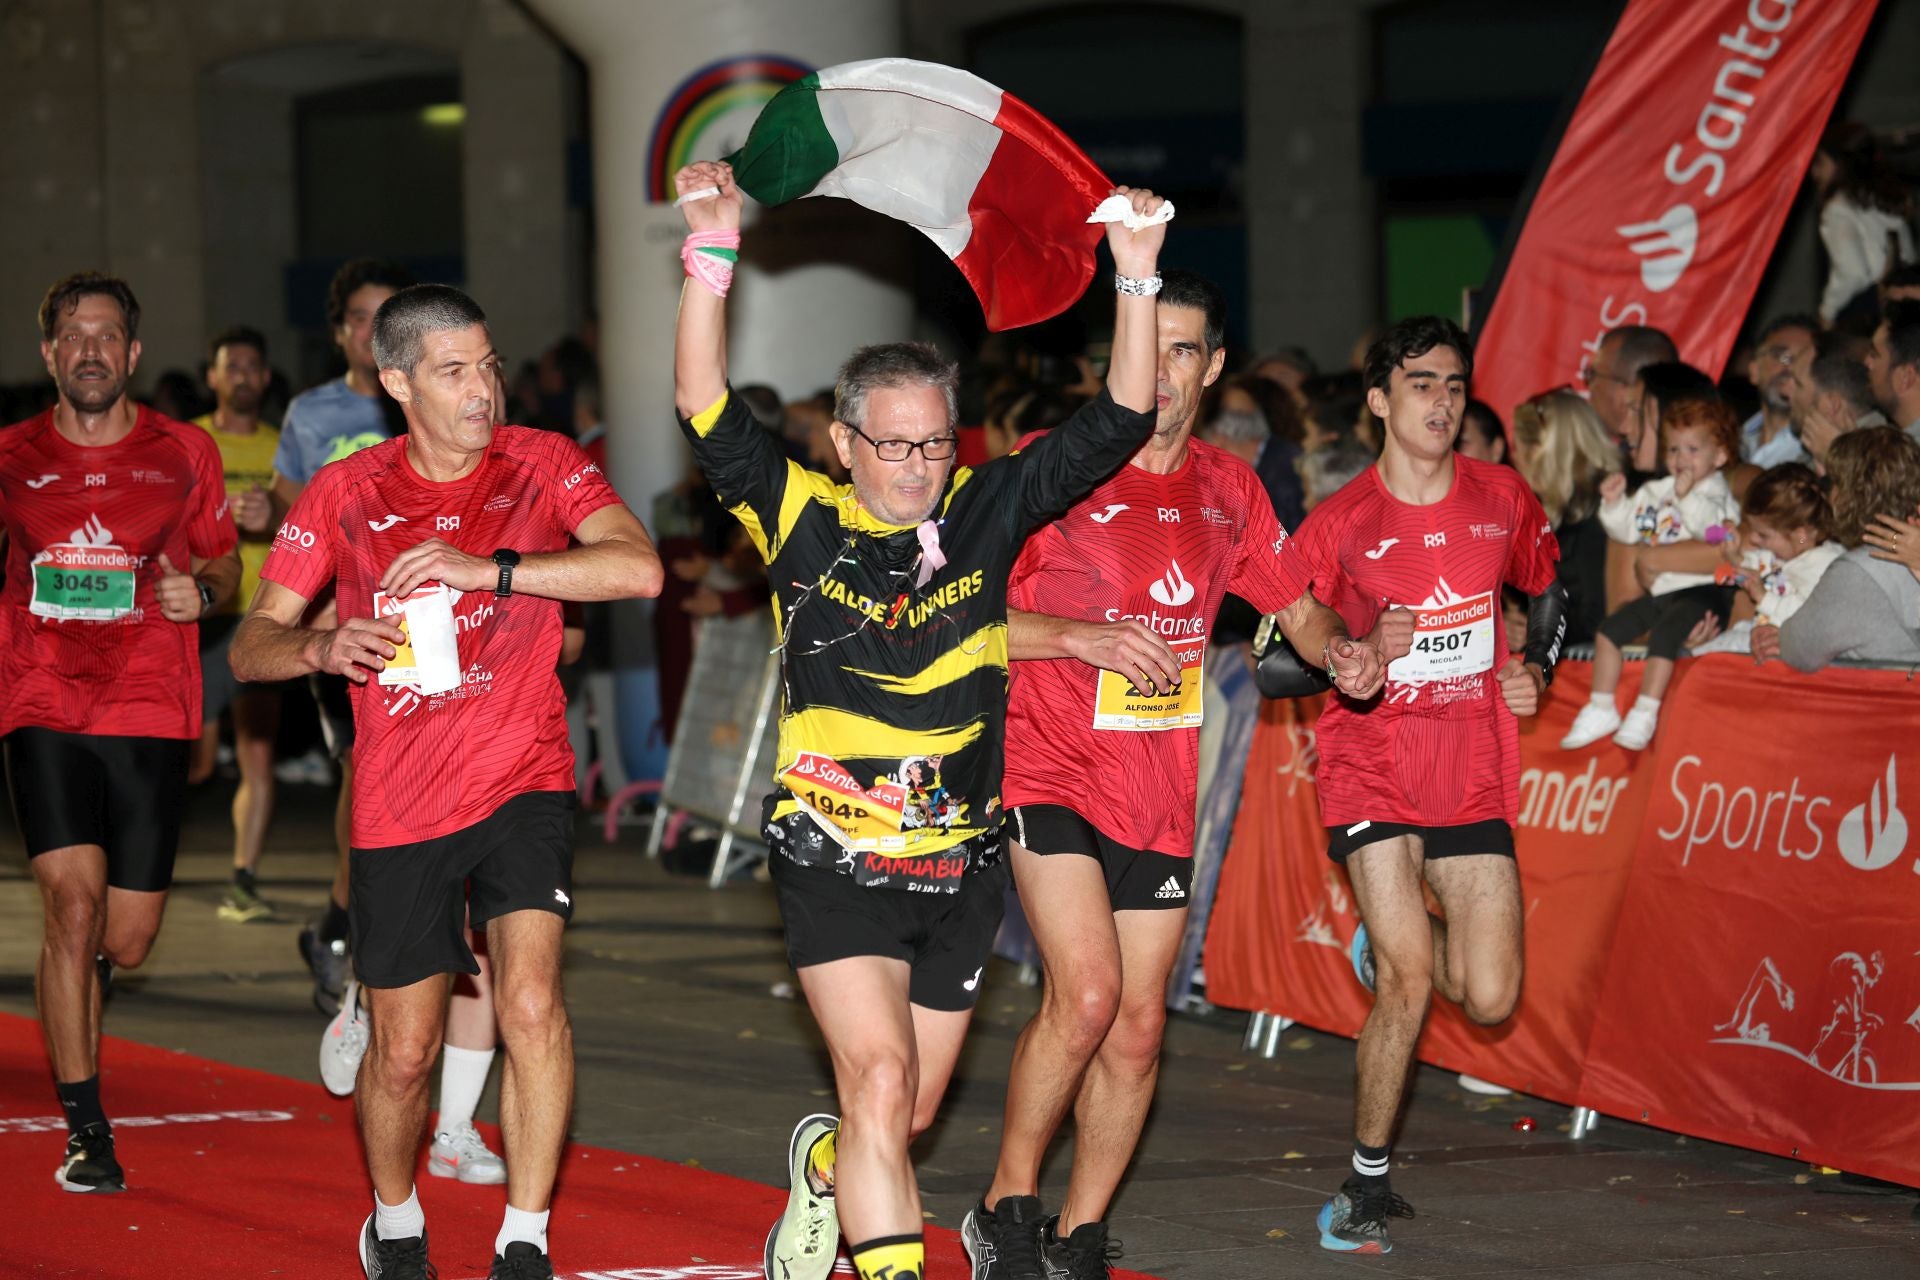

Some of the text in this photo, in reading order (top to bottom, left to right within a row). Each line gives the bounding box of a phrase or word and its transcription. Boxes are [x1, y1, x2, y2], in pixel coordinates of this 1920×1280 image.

[53, 573, 109, 592] 3045
[1418, 601, 1489, 627] Santander
[1416, 630, 1472, 653] 4507
[1429, 655, 1463, 665] NICOLAS
[1125, 703, 1164, 712] ALFONSO
[1517, 756, 1629, 835] ander
[1657, 755, 1832, 867] Sports
[864, 852, 965, 880] KAMUABU
